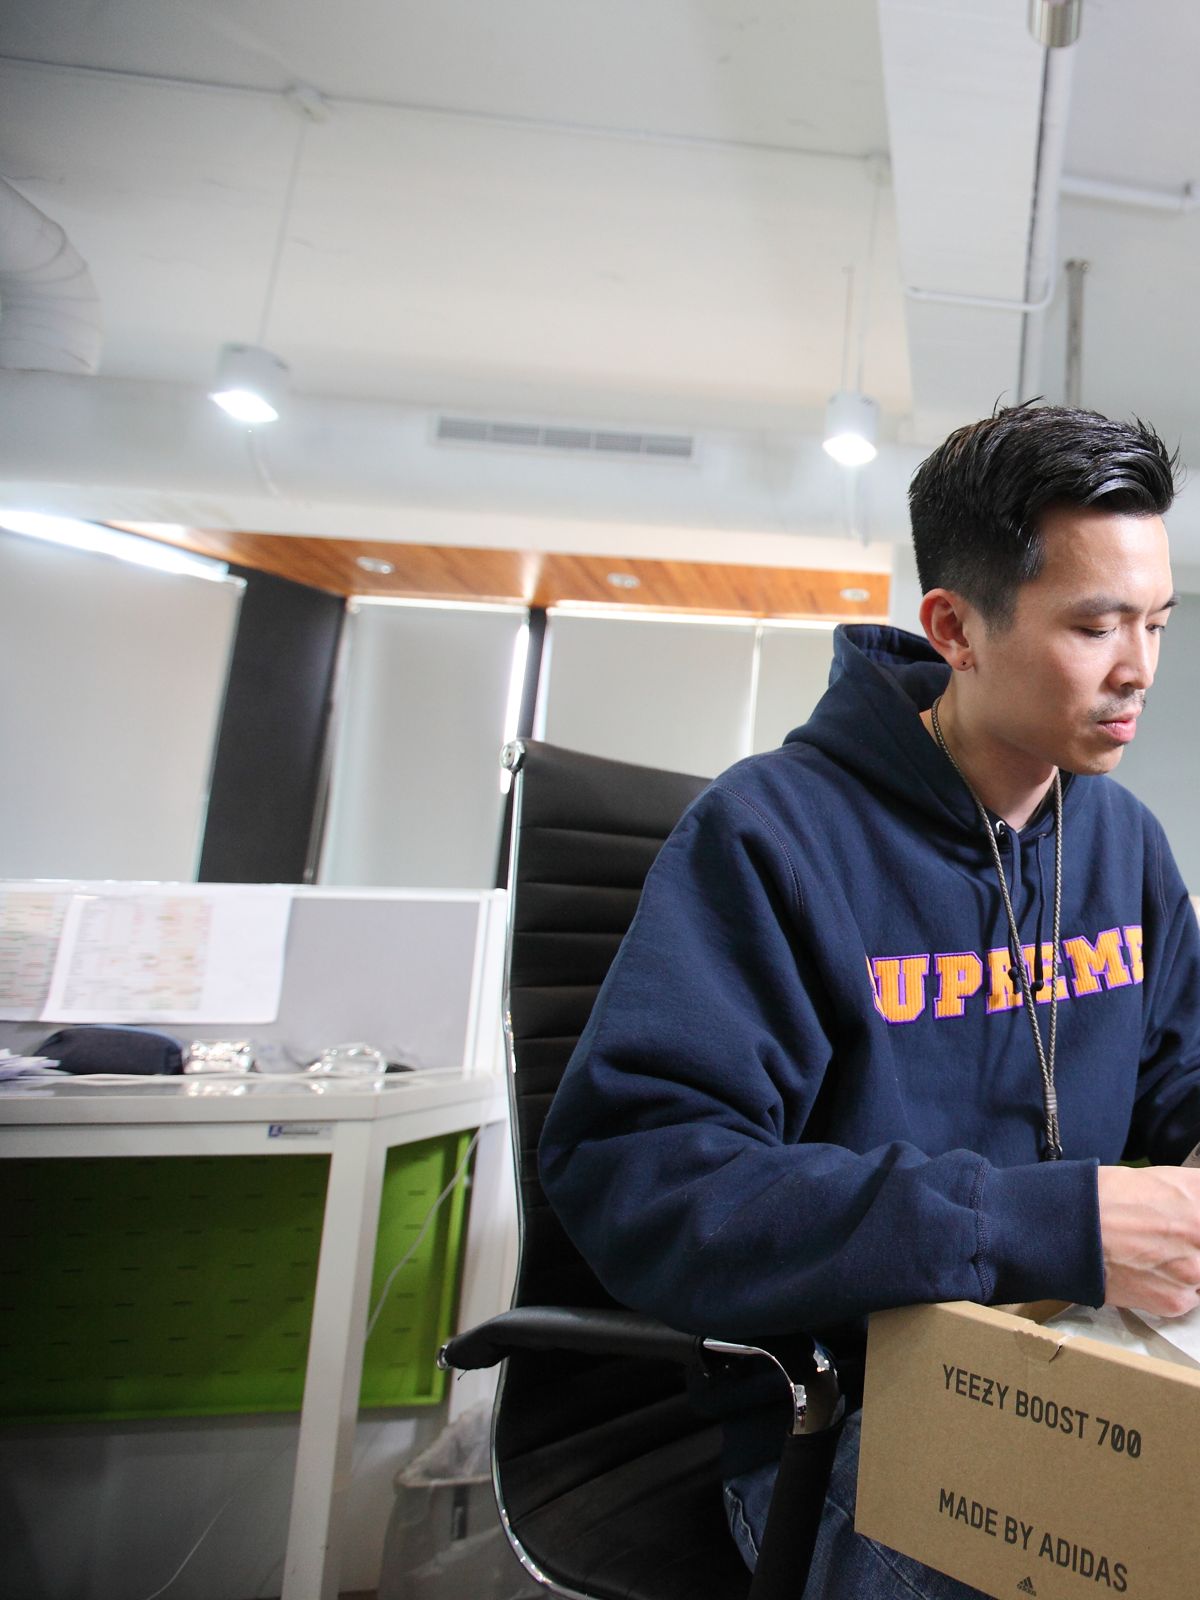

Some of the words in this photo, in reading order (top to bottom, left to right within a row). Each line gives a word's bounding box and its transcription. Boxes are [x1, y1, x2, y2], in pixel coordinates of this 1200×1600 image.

[866, 924, 1144, 1026] UPREM
[942, 1363, 1010, 1410] YEEZY
[1015, 1389, 1090, 1439] BOOST
[1095, 1416, 1143, 1459] 700
[938, 1487, 999, 1537] MADE
[1004, 1515, 1034, 1551] BY
[1038, 1532, 1128, 1593] ADIDAS
